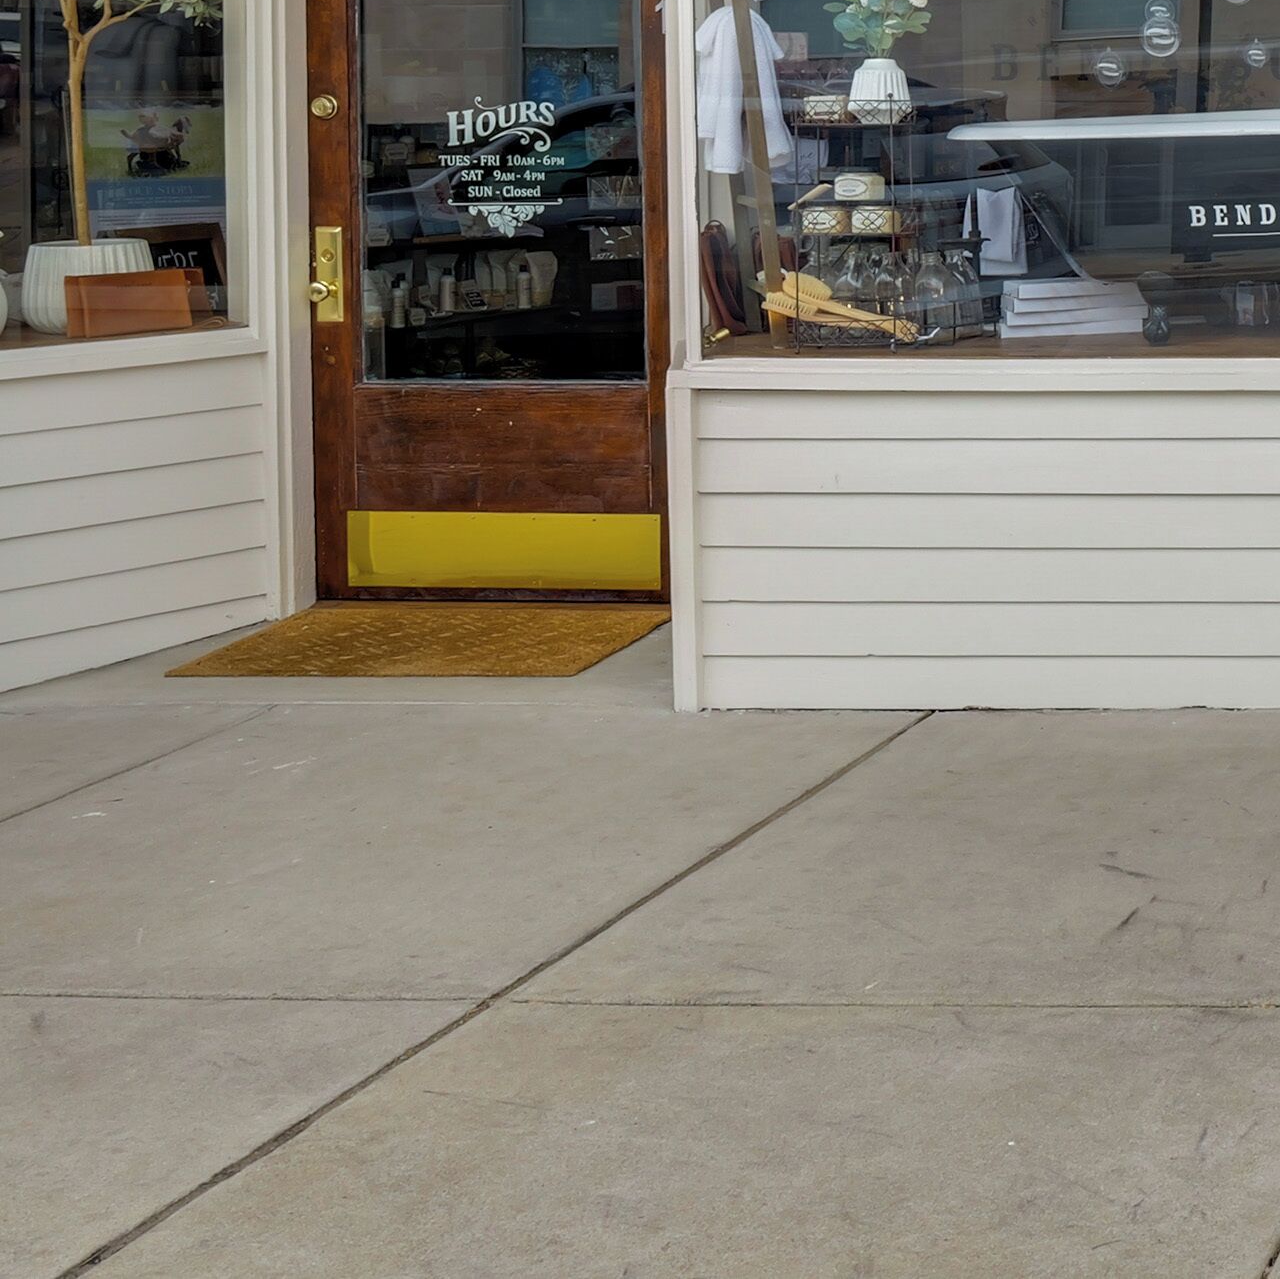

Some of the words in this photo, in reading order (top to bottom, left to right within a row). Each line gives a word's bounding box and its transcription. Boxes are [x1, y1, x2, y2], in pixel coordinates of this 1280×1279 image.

[446, 99, 555, 147] HOURS
[438, 155, 470, 166] TUES
[480, 155, 500, 166] FRI
[461, 170, 484, 181] SAT
[468, 186, 493, 197] SUN
[502, 185, 541, 197] Closed
[1188, 204, 1277, 227] BEND
